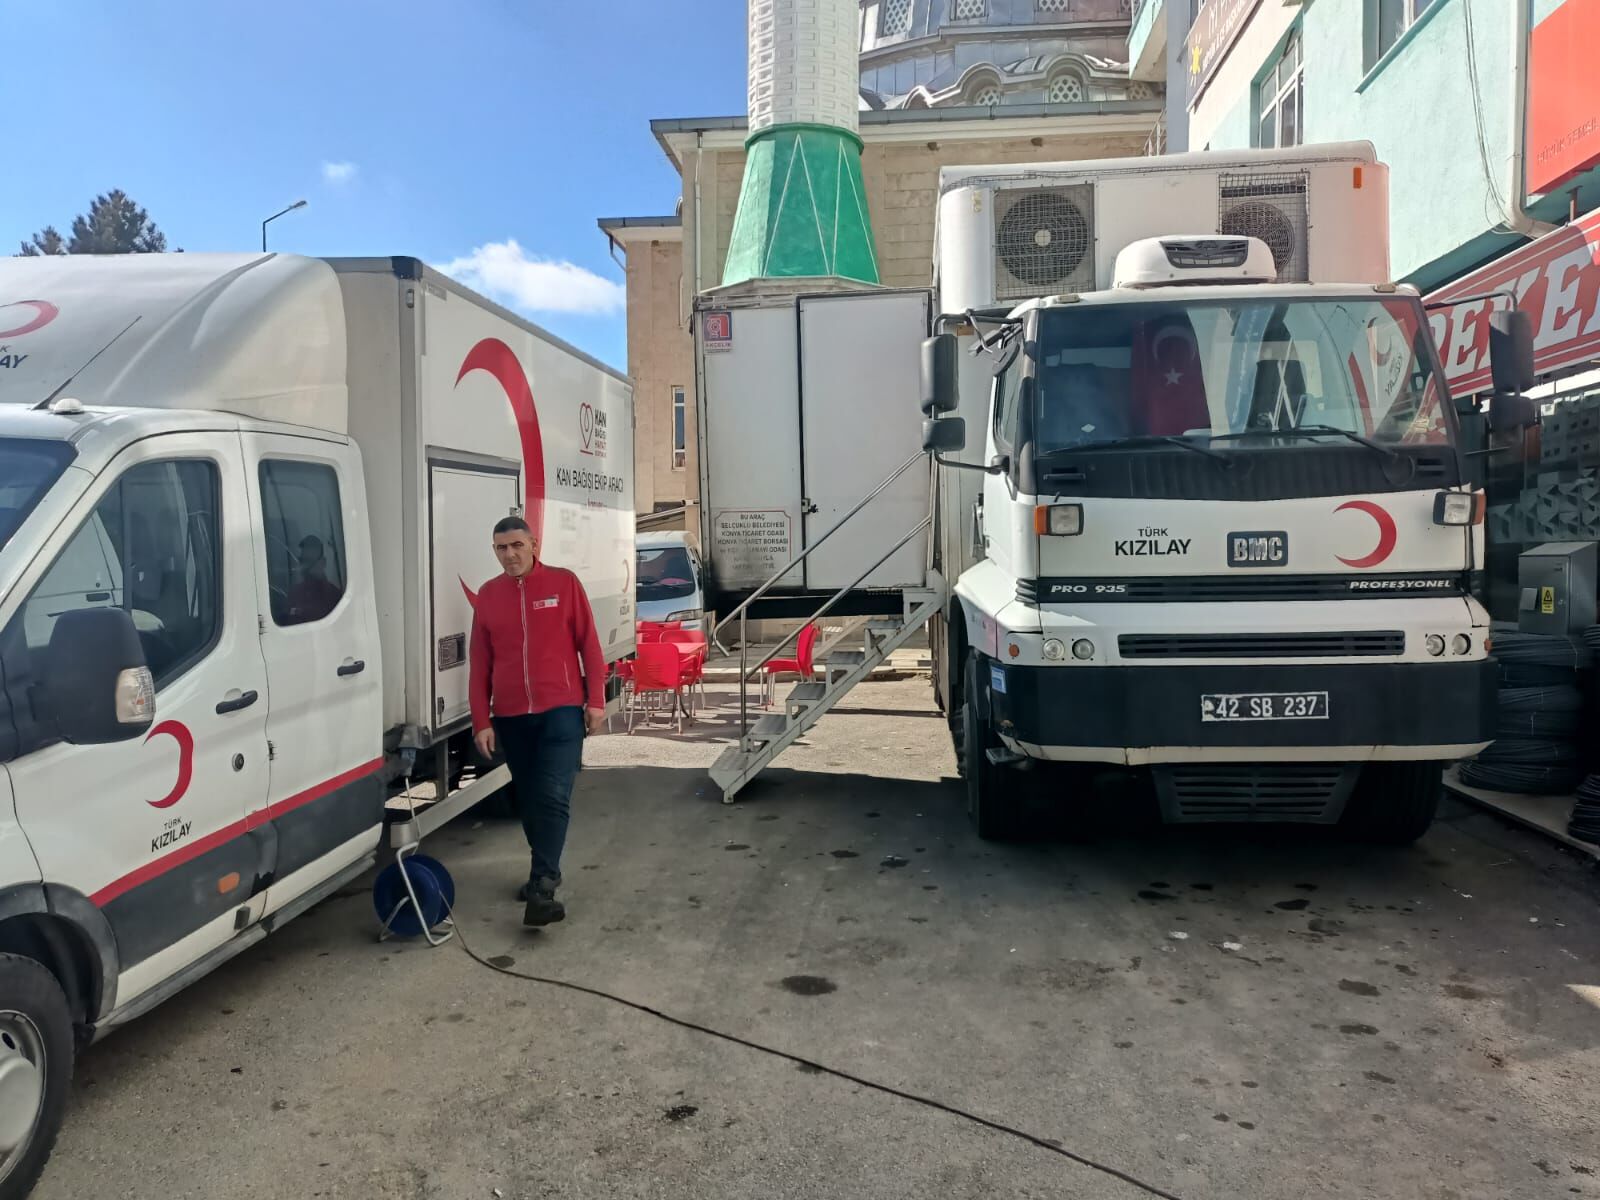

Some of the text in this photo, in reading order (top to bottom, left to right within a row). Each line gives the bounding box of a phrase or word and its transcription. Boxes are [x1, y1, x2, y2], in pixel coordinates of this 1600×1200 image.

[594, 408, 607, 428] KAN
[556, 467, 571, 487] KAN
[572, 468, 594, 492] BAĞIŞI
[594, 472, 608, 491] EKİP
[1138, 526, 1169, 537] TÜRK
[1114, 538, 1192, 556] KIZILAY
[1233, 537, 1283, 562] BMC
[1050, 584, 1126, 593] PRO 935
[1349, 580, 1451, 590] PROFESYONEL
[1216, 695, 1318, 718] 42 SB 237
[151, 821, 192, 852] KIZILAY
